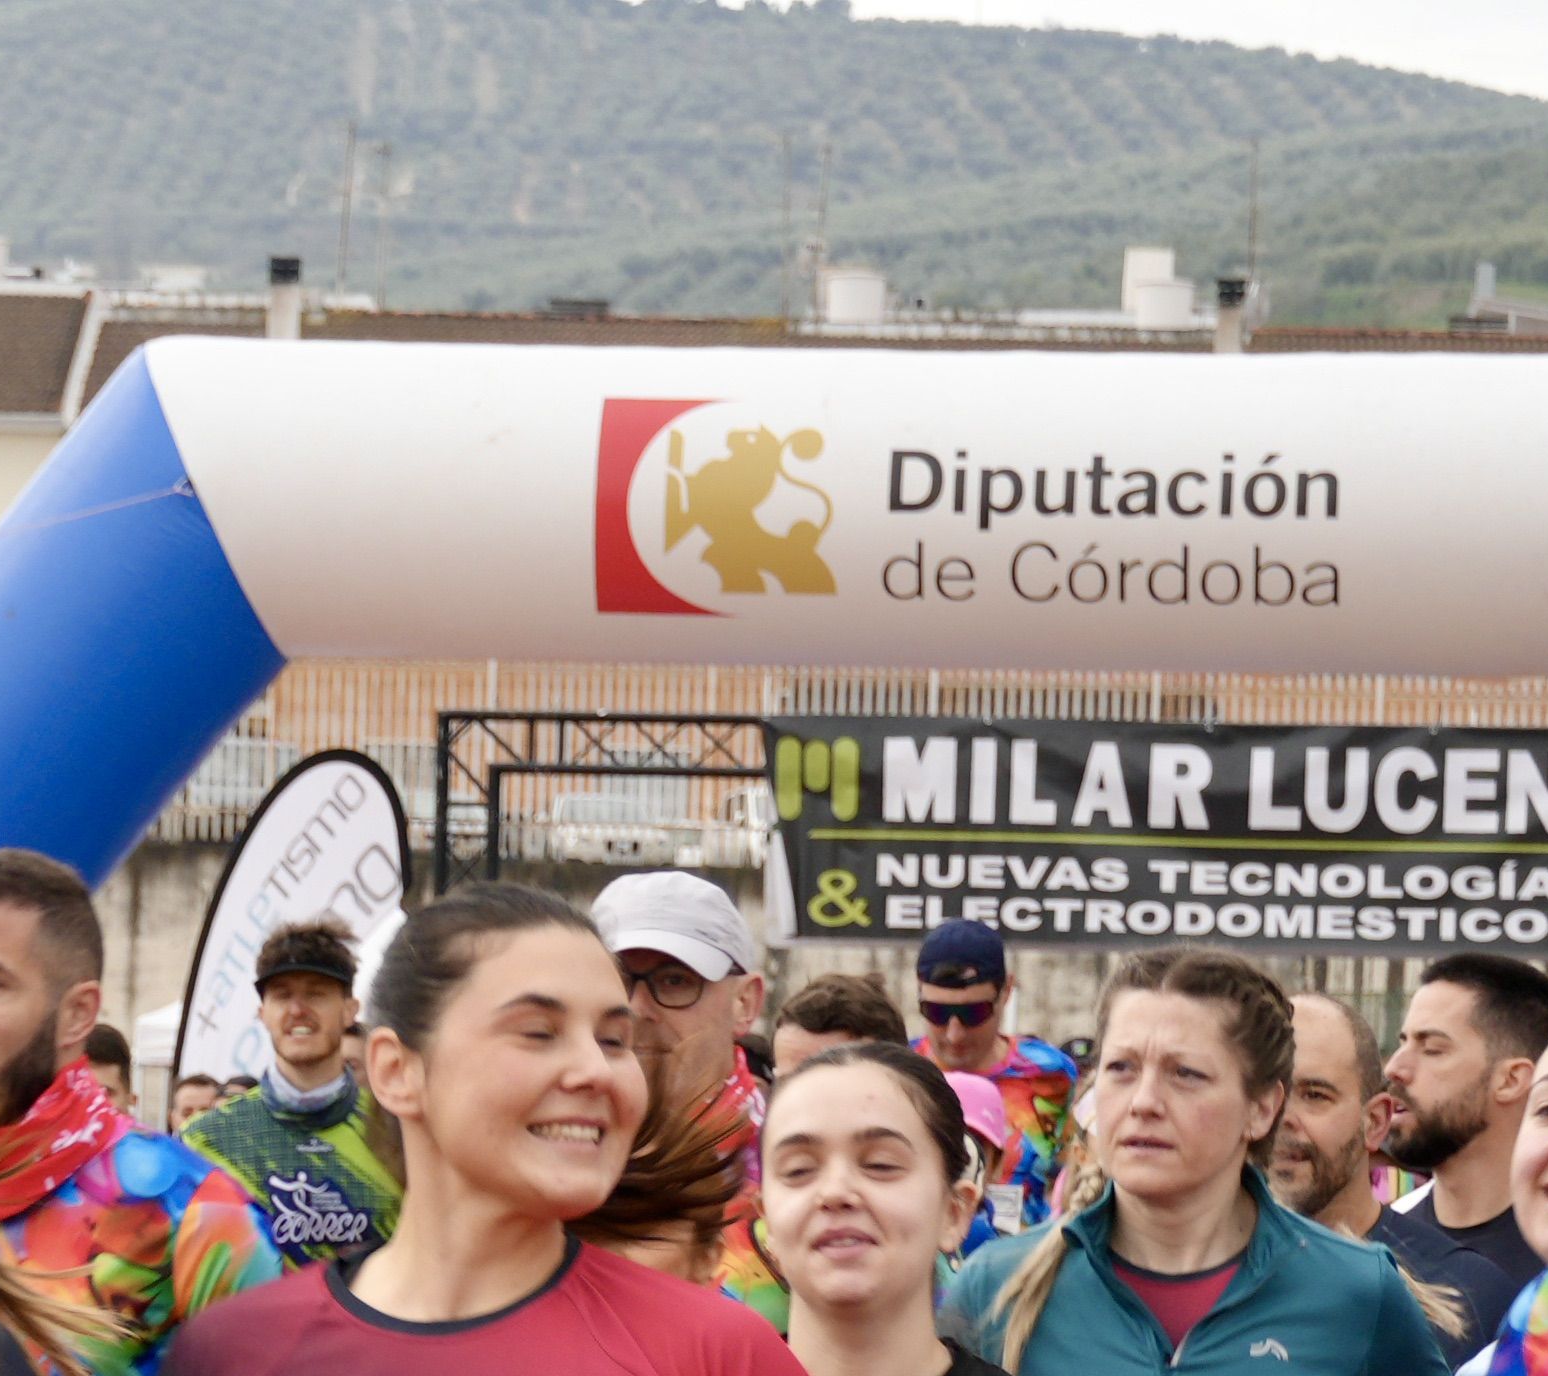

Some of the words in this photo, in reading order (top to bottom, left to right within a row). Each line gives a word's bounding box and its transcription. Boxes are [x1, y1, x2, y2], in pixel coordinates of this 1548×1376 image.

[887, 450, 1341, 531] Diputación
[881, 540, 976, 602] de
[1010, 540, 1341, 607] Córdoba
[881, 735, 1214, 831] MILAR
[806, 868, 872, 928] &
[876, 852, 1130, 892] NUEVAS
[272, 1212, 368, 1244] CORRER
